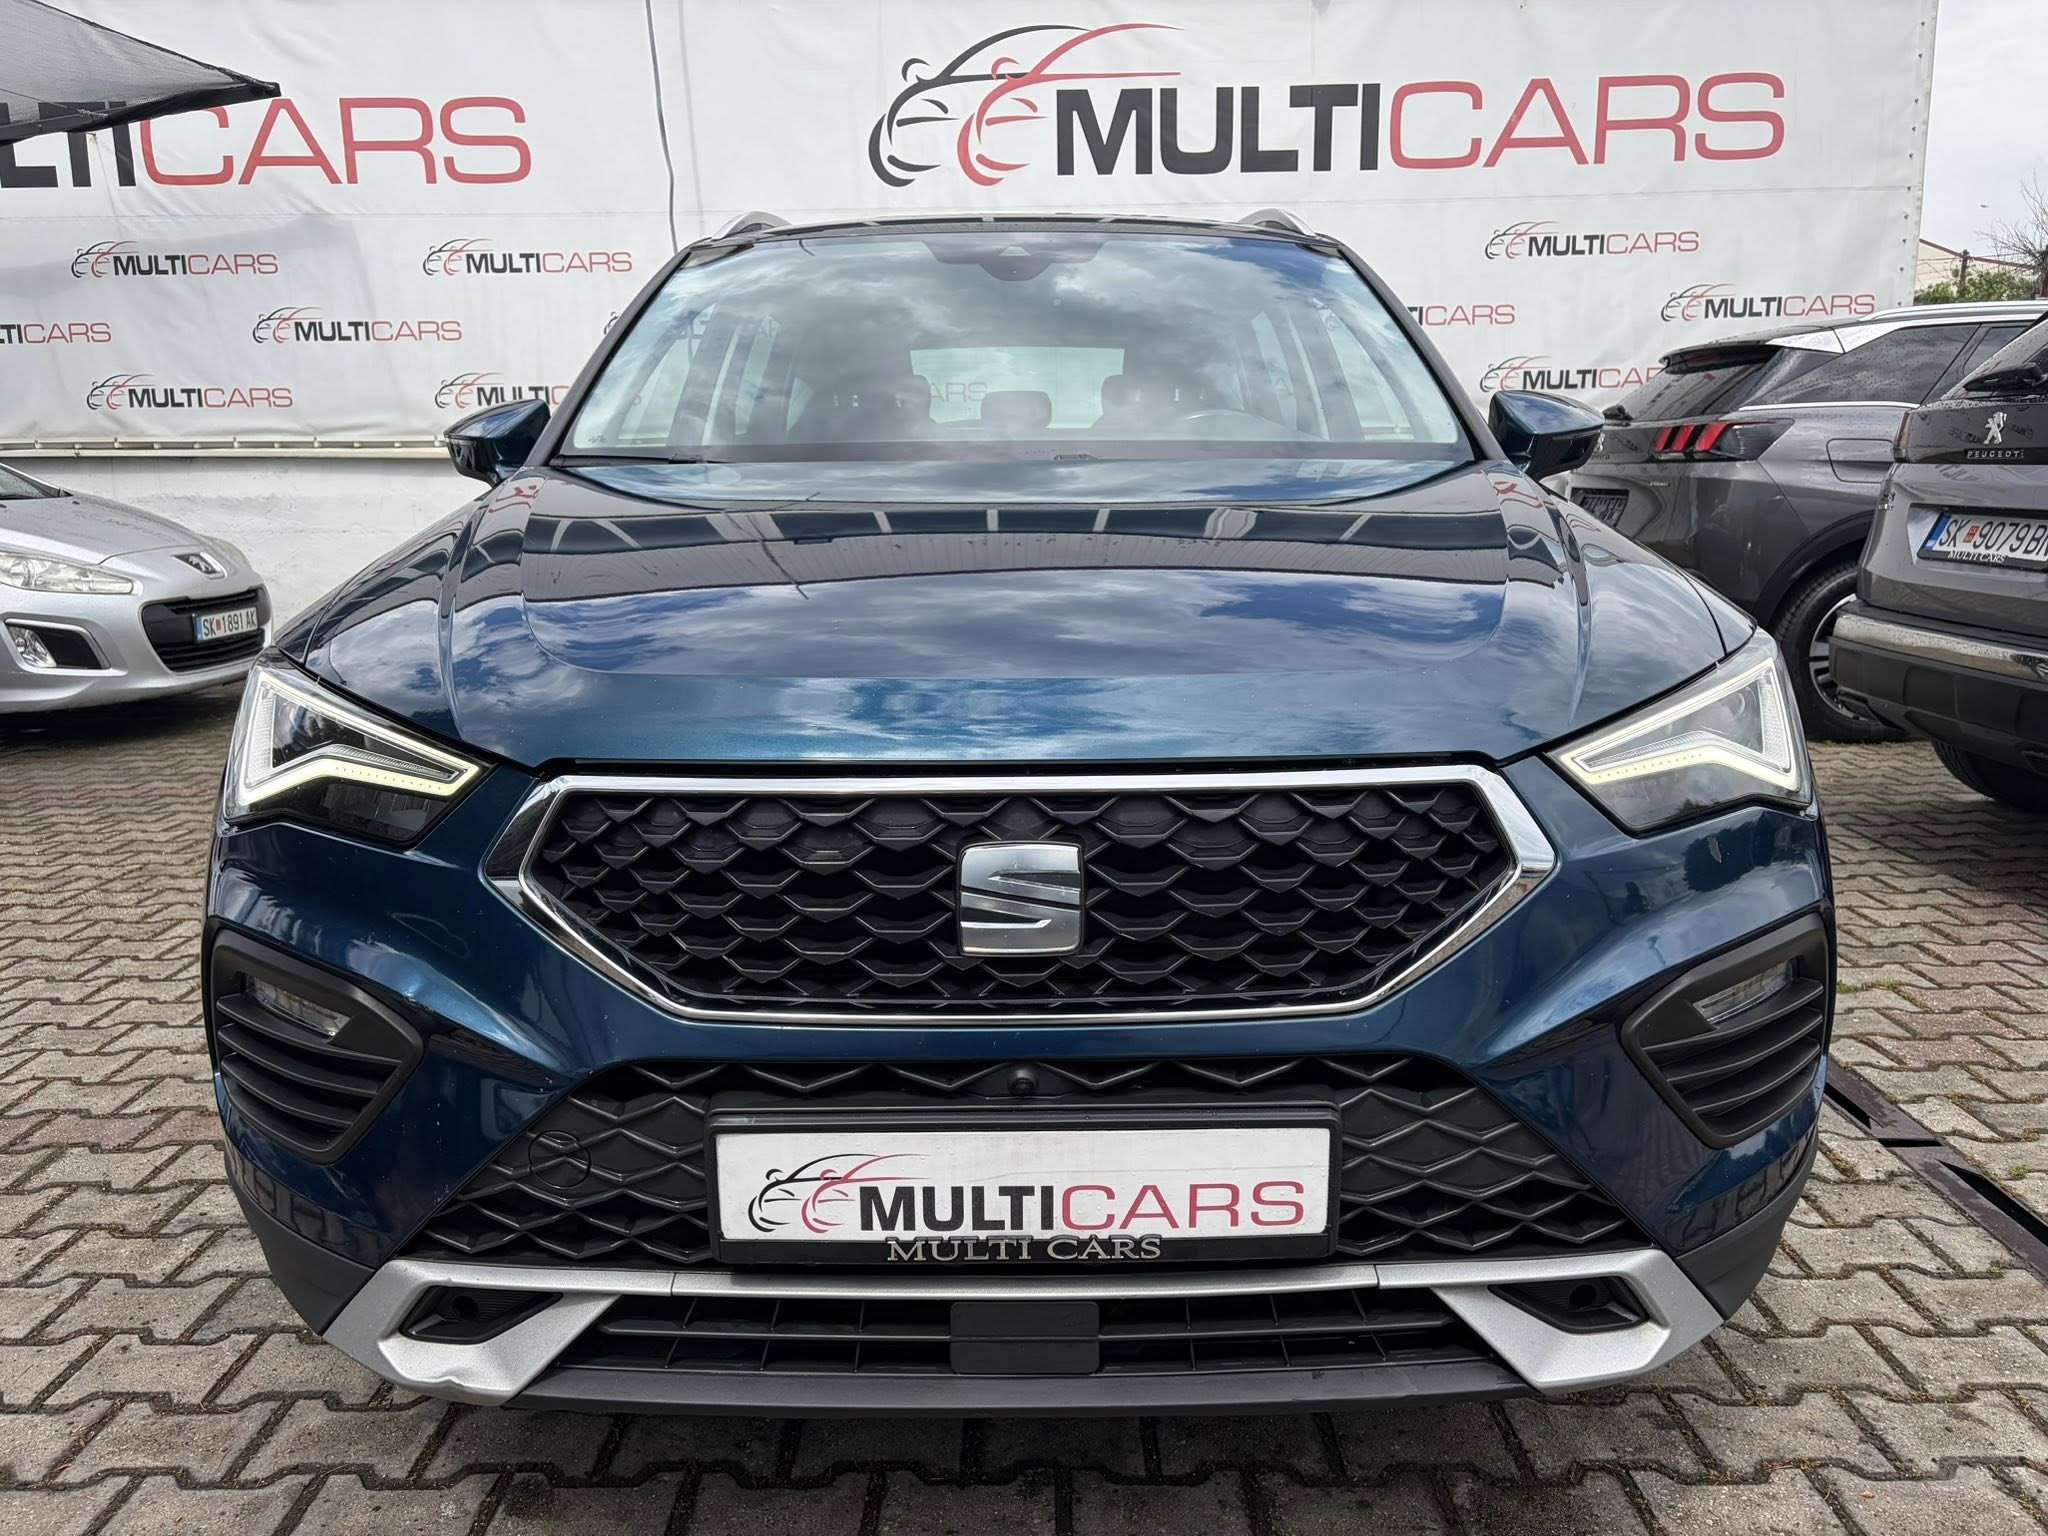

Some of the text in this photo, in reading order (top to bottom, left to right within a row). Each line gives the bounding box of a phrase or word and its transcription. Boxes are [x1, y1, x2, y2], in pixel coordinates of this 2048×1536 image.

[1056, 72, 1786, 175] MULTICARS
[1528, 231, 1700, 256] MULTICARS
[113, 254, 279, 275] MULTICARS
[466, 251, 632, 274] MULTICARS
[1704, 294, 1875, 319] MULTICARS
[0, 323, 111, 344] TICARS
[295, 320, 462, 342] MULTICARS
[129, 387, 294, 409] MULTICARS
[1967, 449, 2021, 460] PEUGEOT
[1938, 519, 1972, 548] SK
[860, 1181, 1304, 1232] MULTICARS
[887, 1236, 1162, 1262] MULTI CARS
